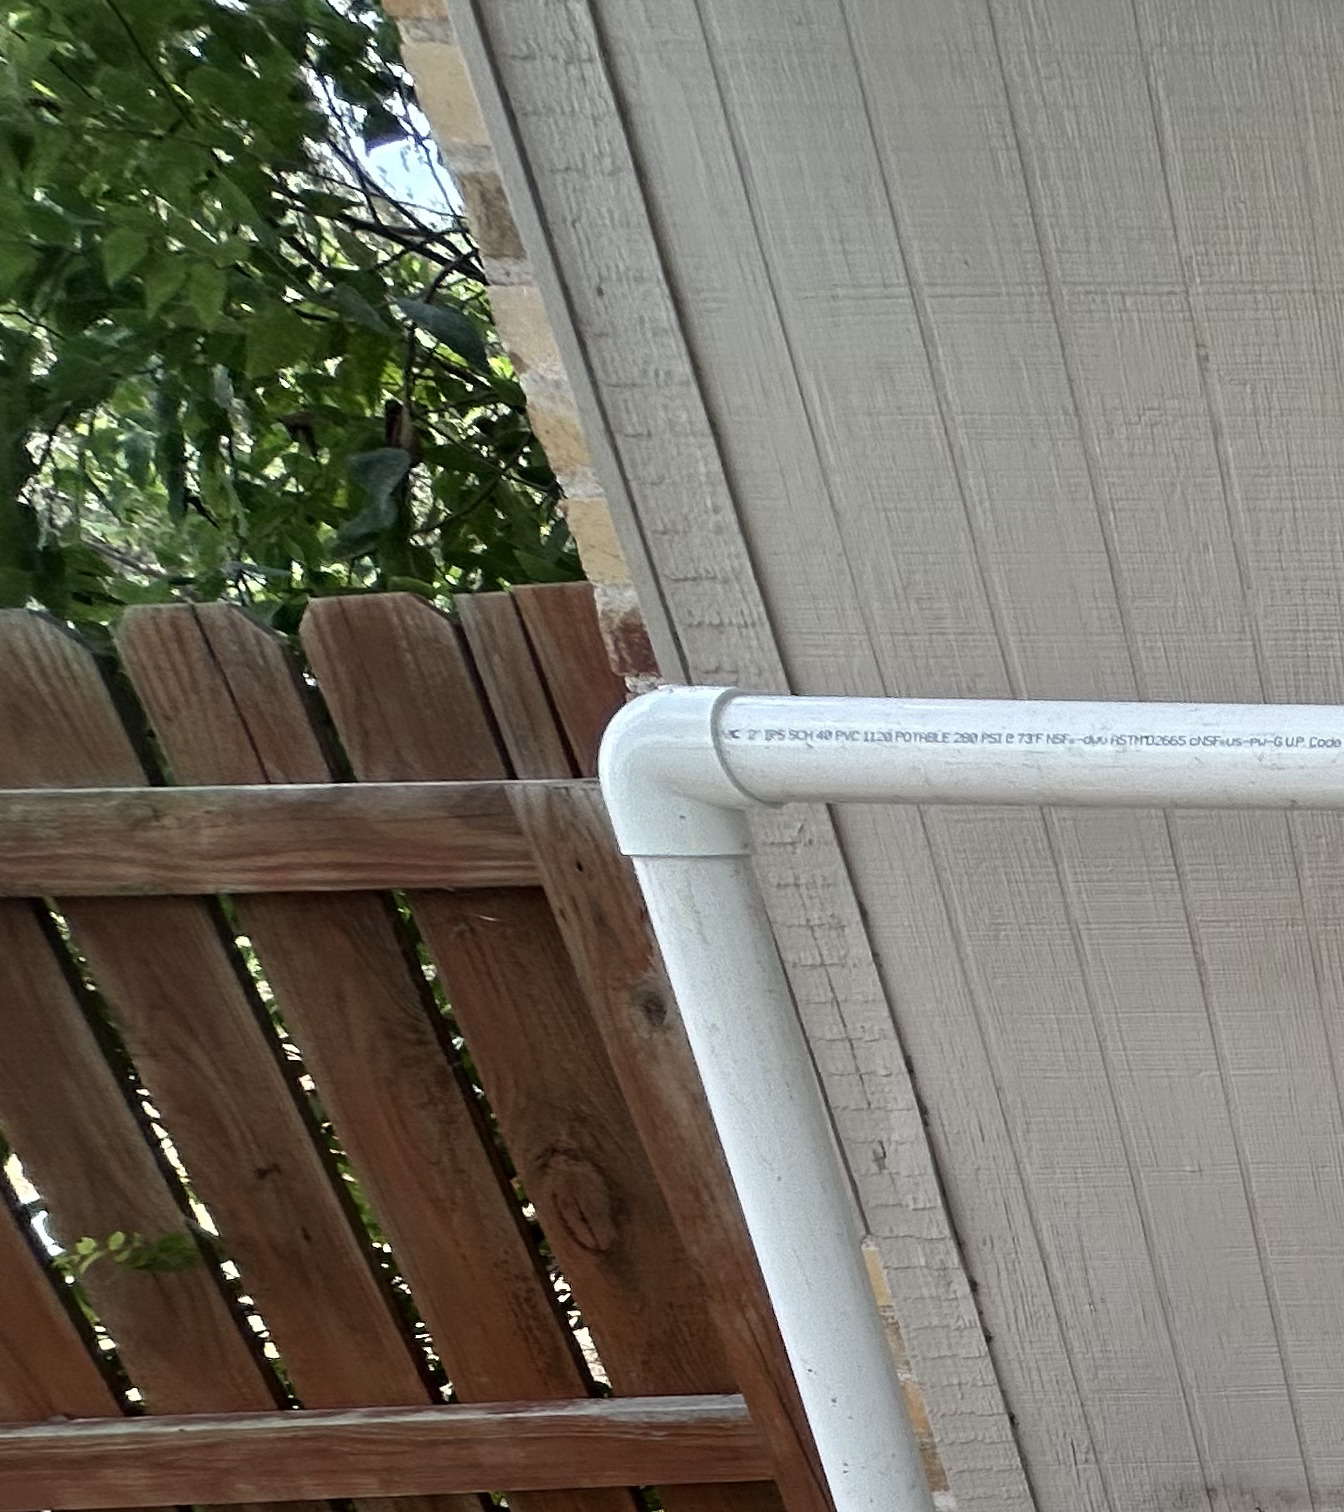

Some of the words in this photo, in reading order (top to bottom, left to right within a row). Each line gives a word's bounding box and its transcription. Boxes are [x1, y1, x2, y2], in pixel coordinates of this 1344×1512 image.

[788, 729, 813, 741] SCH
[816, 729, 833, 741] 40
[835, 730, 860, 742] PVC
[863, 729, 893, 742] 1120
[895, 730, 949, 743] POTABLE
[953, 732, 977, 744] 280
[980, 732, 1001, 744] PSI
[1309, 736, 1341, 748] Code
